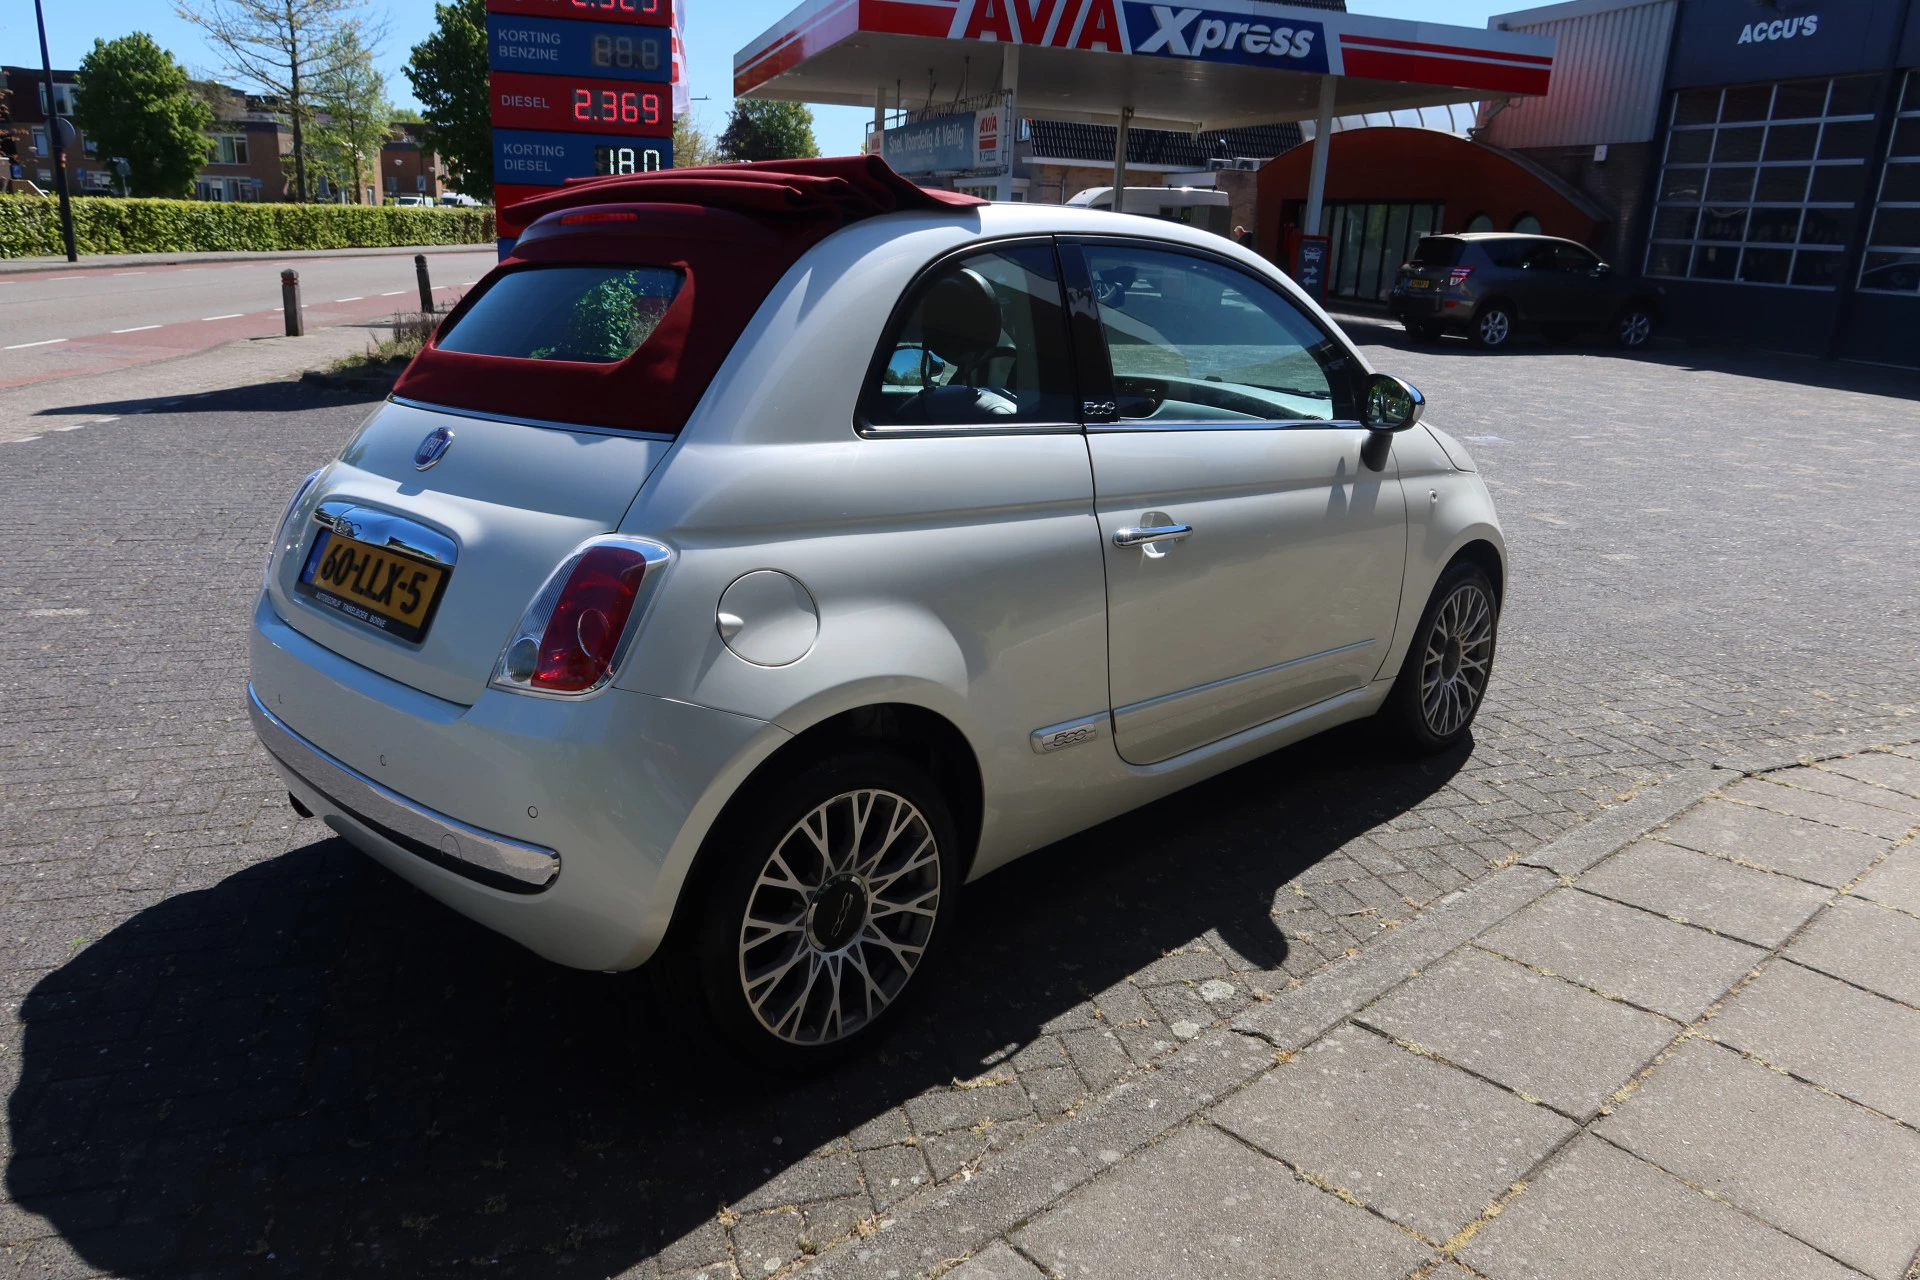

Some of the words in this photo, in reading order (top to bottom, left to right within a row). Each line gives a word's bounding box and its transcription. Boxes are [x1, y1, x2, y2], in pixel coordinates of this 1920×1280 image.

[498, 28, 561, 45] KORTING
[962, 0, 1125, 53] AVIA
[1135, 5, 1315, 59] Xpress
[1737, 14, 1819, 45] ACCU'S
[499, 45, 559, 61] BENZINE
[501, 94, 550, 109] DIESEL
[574, 88, 659, 124] 2.369
[503, 143, 565, 157] KORTING
[904, 129, 933, 153] Voordelig
[934, 127, 940, 147] &
[943, 123, 964, 150] Veilig
[504, 159, 553, 172] DIESEL
[320, 543, 427, 615] 60-LLX-5
